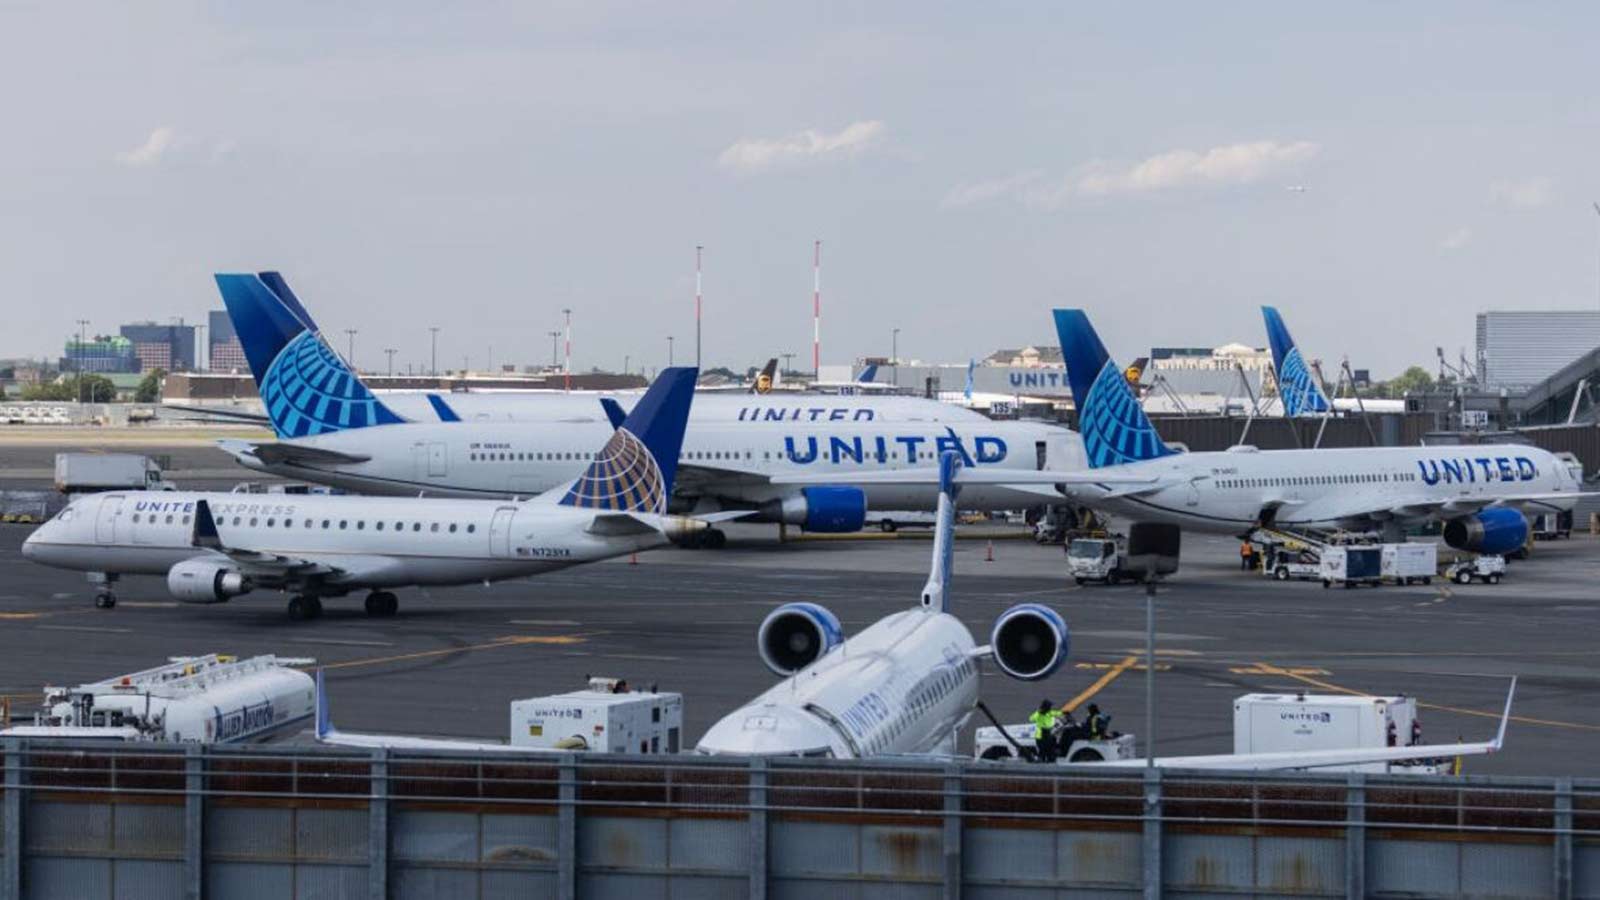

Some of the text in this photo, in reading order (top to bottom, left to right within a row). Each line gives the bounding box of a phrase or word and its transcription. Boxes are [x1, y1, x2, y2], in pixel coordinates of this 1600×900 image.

[1010, 373, 1070, 387] UNITE
[1417, 457, 1535, 486] UNITED
[135, 501, 296, 515] UNITE EXPRESS
[535, 708, 573, 718] UNITED
[841, 692, 889, 736] UNITED
[1280, 712, 1320, 720] UNITED
